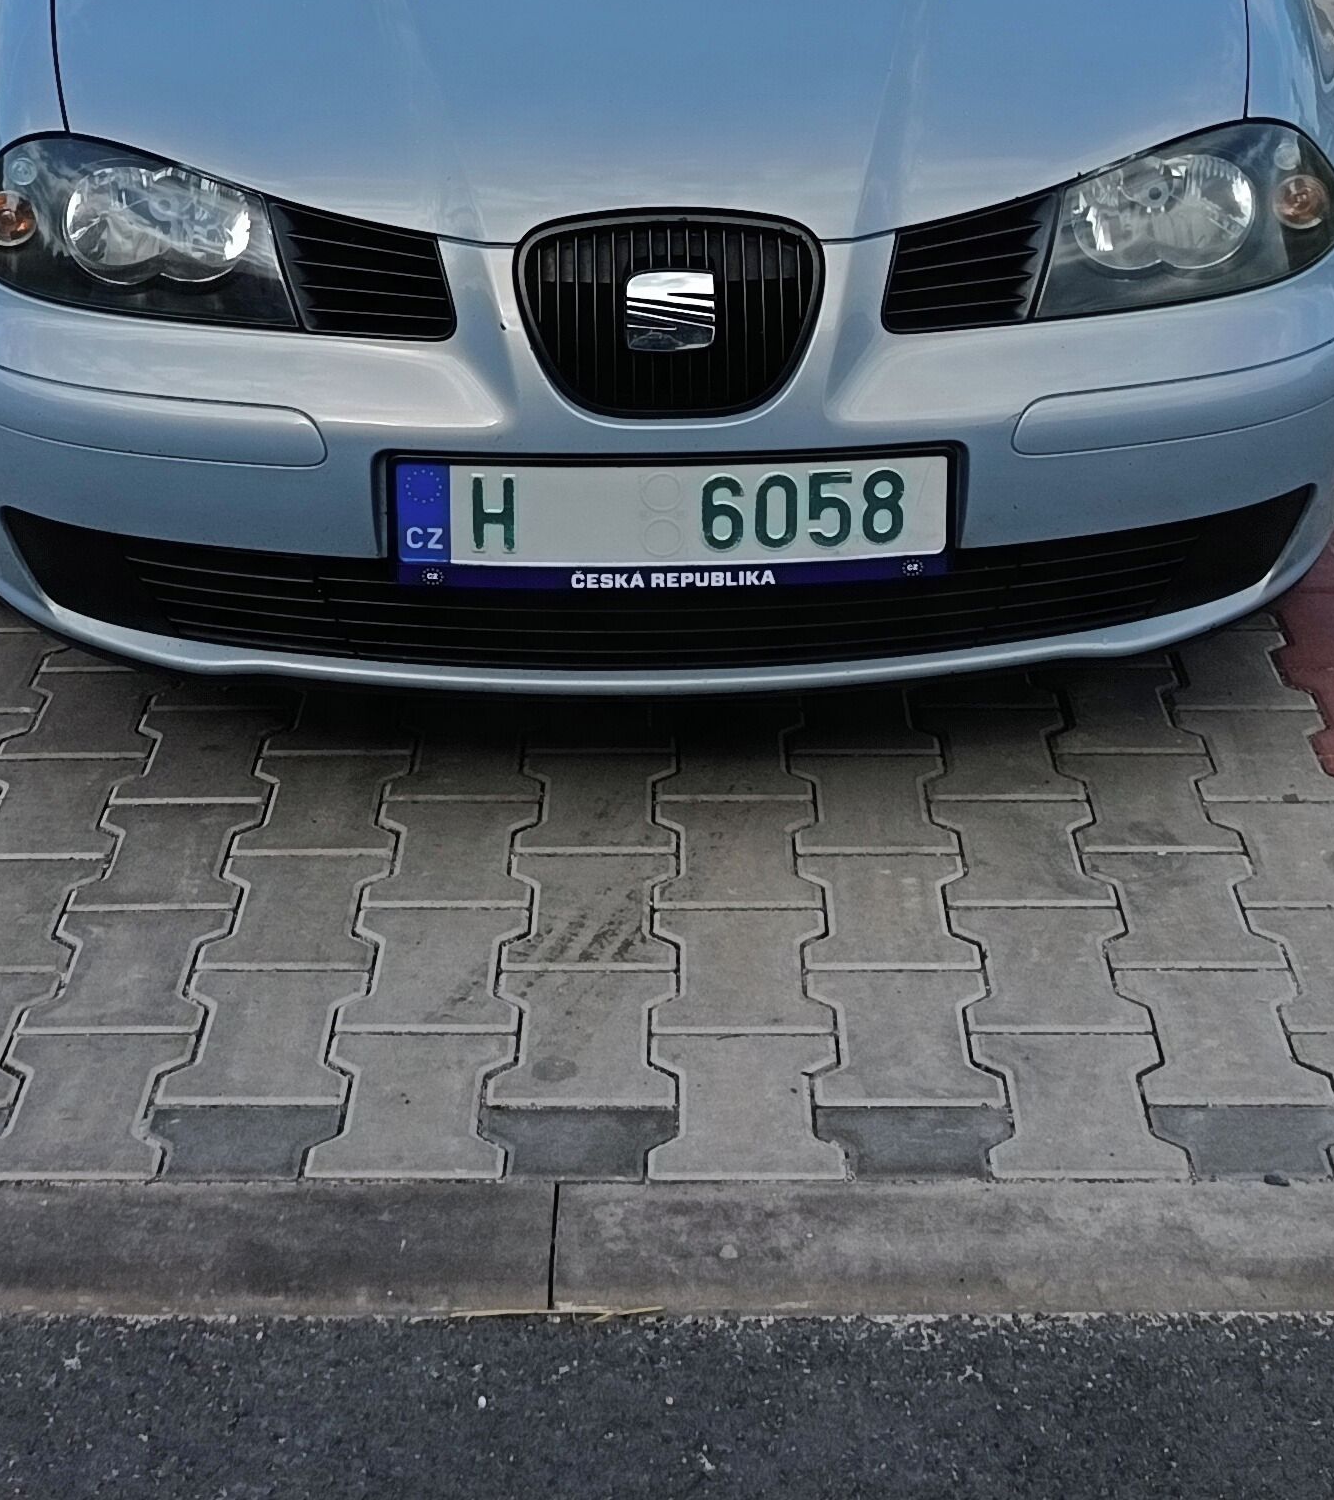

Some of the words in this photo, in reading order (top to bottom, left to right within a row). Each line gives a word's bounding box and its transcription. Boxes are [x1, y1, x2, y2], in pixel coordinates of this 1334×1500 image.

[470, 473, 517, 553] H
[700, 467, 905, 552] 6058
[406, 526, 444, 550] CZ
[570, 570, 645, 589] ČESKÁ
[650, 569, 776, 588] REPUBLIKA
